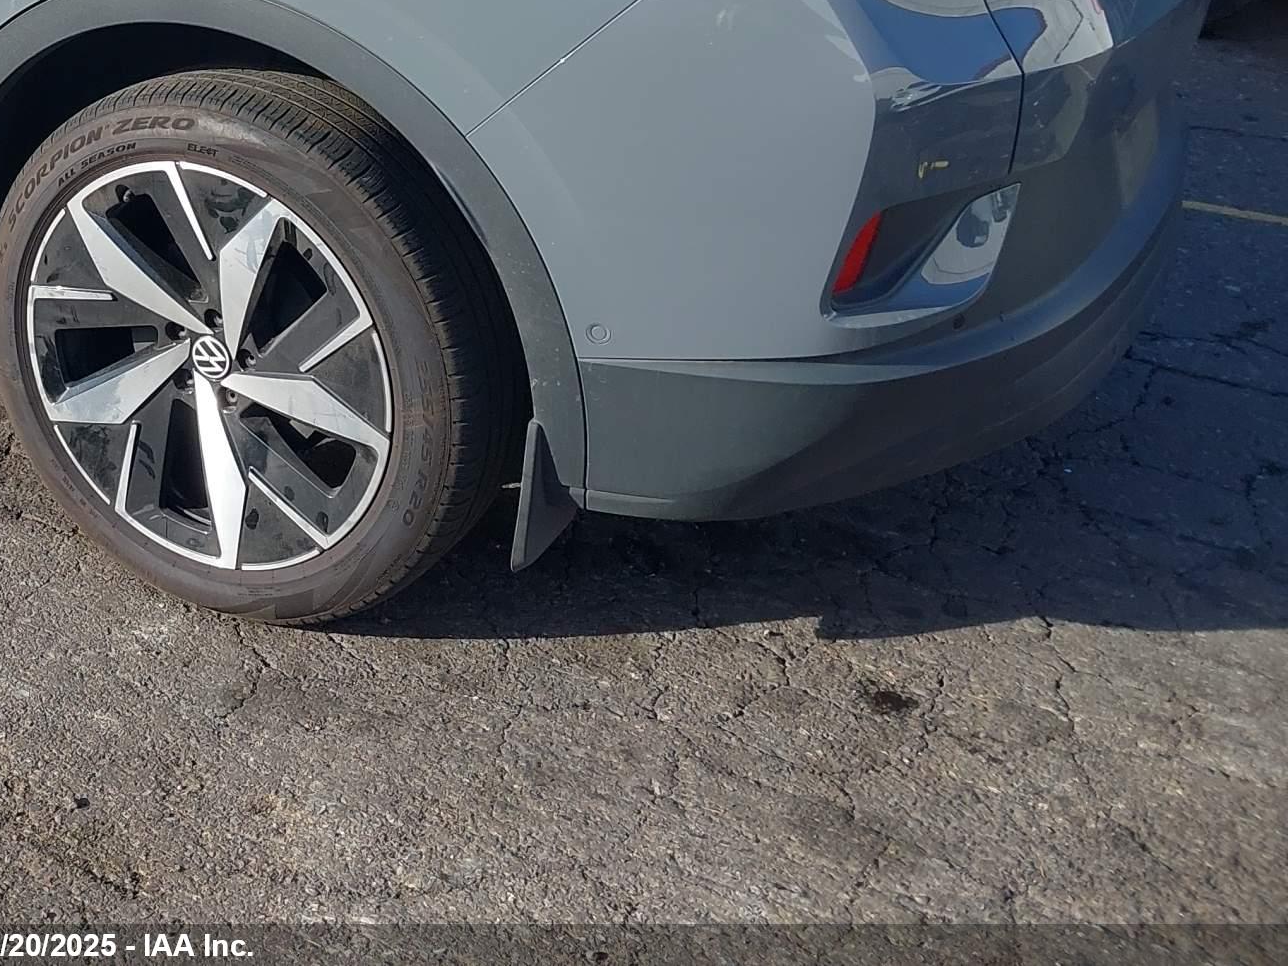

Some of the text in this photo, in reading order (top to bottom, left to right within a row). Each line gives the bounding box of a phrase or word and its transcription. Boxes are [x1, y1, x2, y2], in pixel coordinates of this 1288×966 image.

[8, 116, 196, 232] SCORPION ZERO
[56, 141, 138, 187] ALL SEASON
